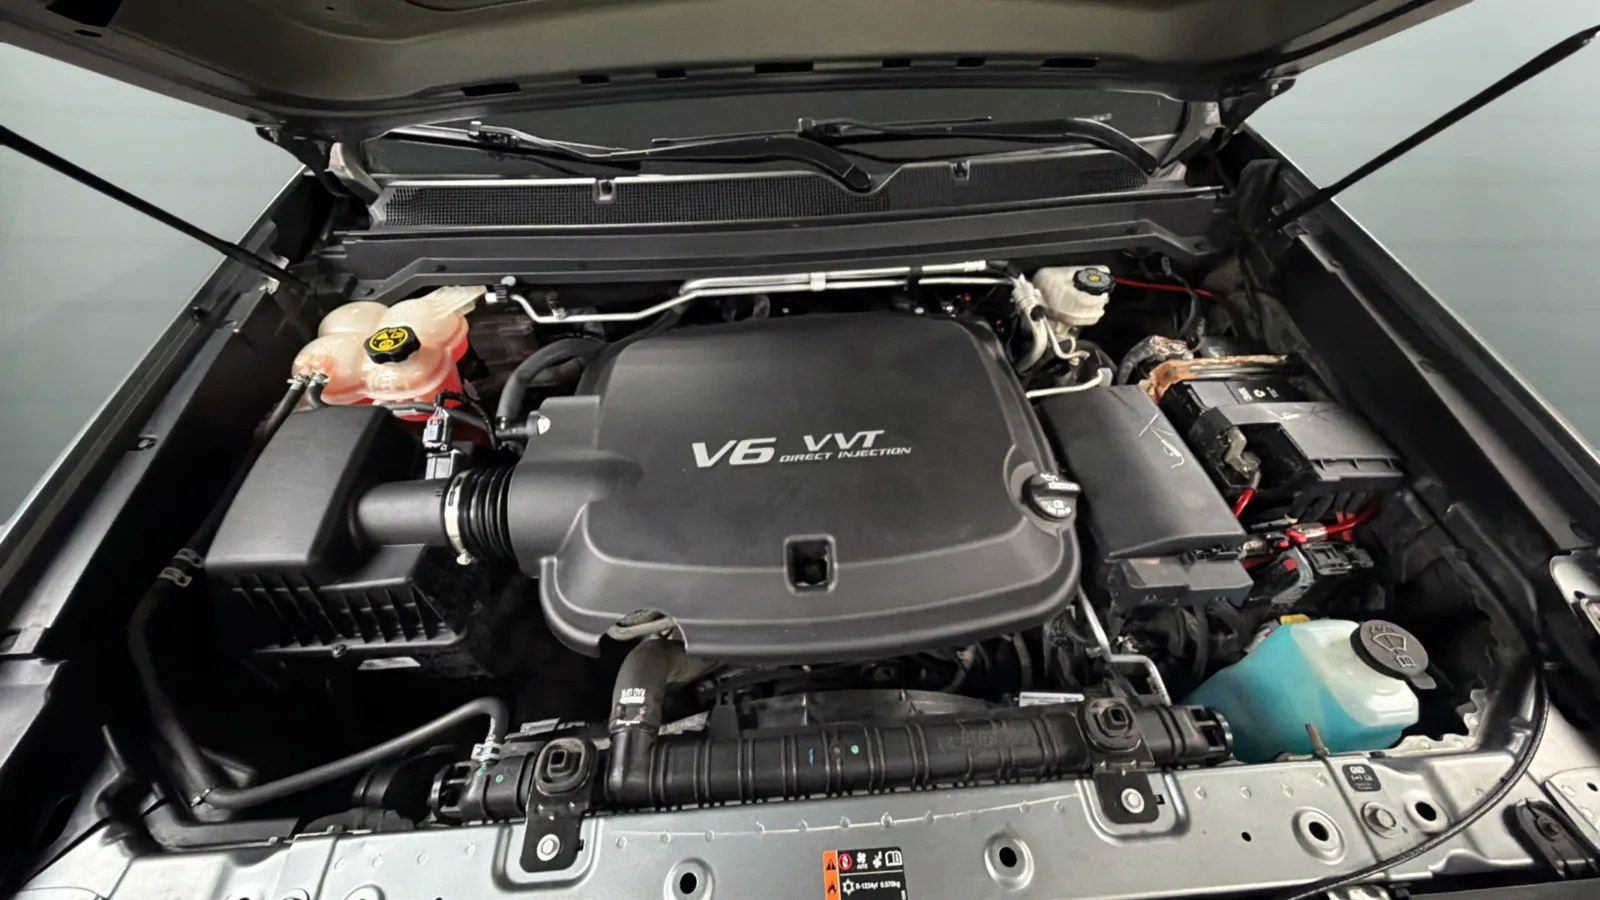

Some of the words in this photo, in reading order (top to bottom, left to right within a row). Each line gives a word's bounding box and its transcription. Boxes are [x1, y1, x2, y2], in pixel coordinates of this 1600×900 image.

[803, 430, 885, 452] VVT
[692, 437, 777, 468] V6
[779, 452, 833, 463] DIRECT
[837, 447, 912, 459] INJECTION
